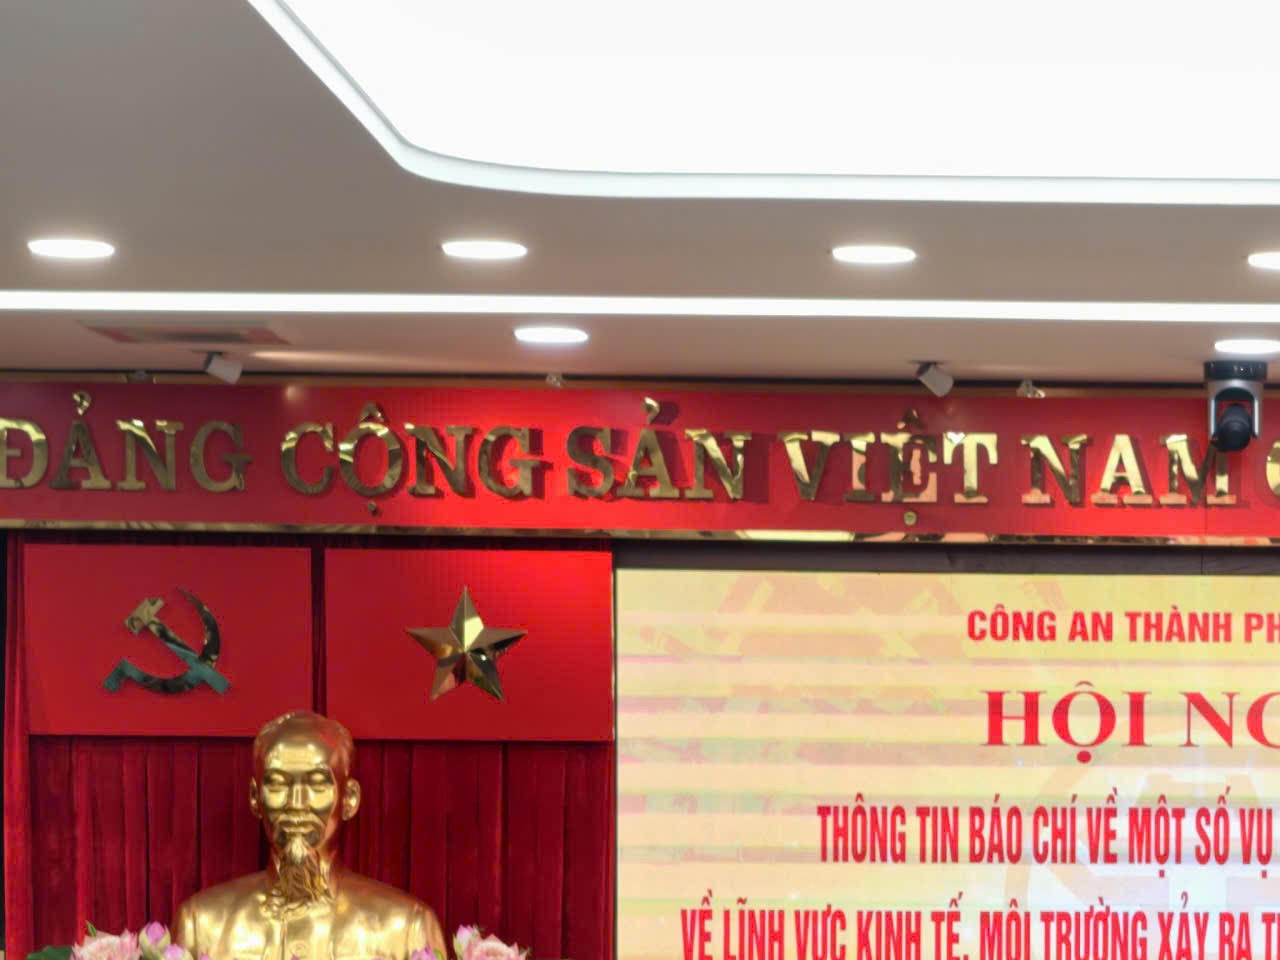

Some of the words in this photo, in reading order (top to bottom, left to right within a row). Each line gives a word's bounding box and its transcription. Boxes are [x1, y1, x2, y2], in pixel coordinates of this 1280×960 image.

[0, 390, 252, 492] ĐẢNG
[281, 403, 546, 515] CỘNG
[567, 397, 751, 501] SẢN
[778, 409, 998, 525] VIỆT
[1021, 434, 1236, 505] NAM
[967, 604, 1056, 642] CÔNG
[1068, 611, 1113, 642] AN
[1125, 606, 1232, 643] THÀNH
[981, 681, 1152, 763] HỘI
[816, 793, 906, 863] THÔNG
[915, 806, 959, 863] TIN
[969, 794, 1023, 864] BÁO
[1032, 794, 1077, 864] CHÍ
[1086, 787, 1118, 864] VỀ
[1128, 795, 1186, 877] MỘT
[1194, 786, 1230, 865] SỐ
[1239, 808, 1272, 879] VỤ
